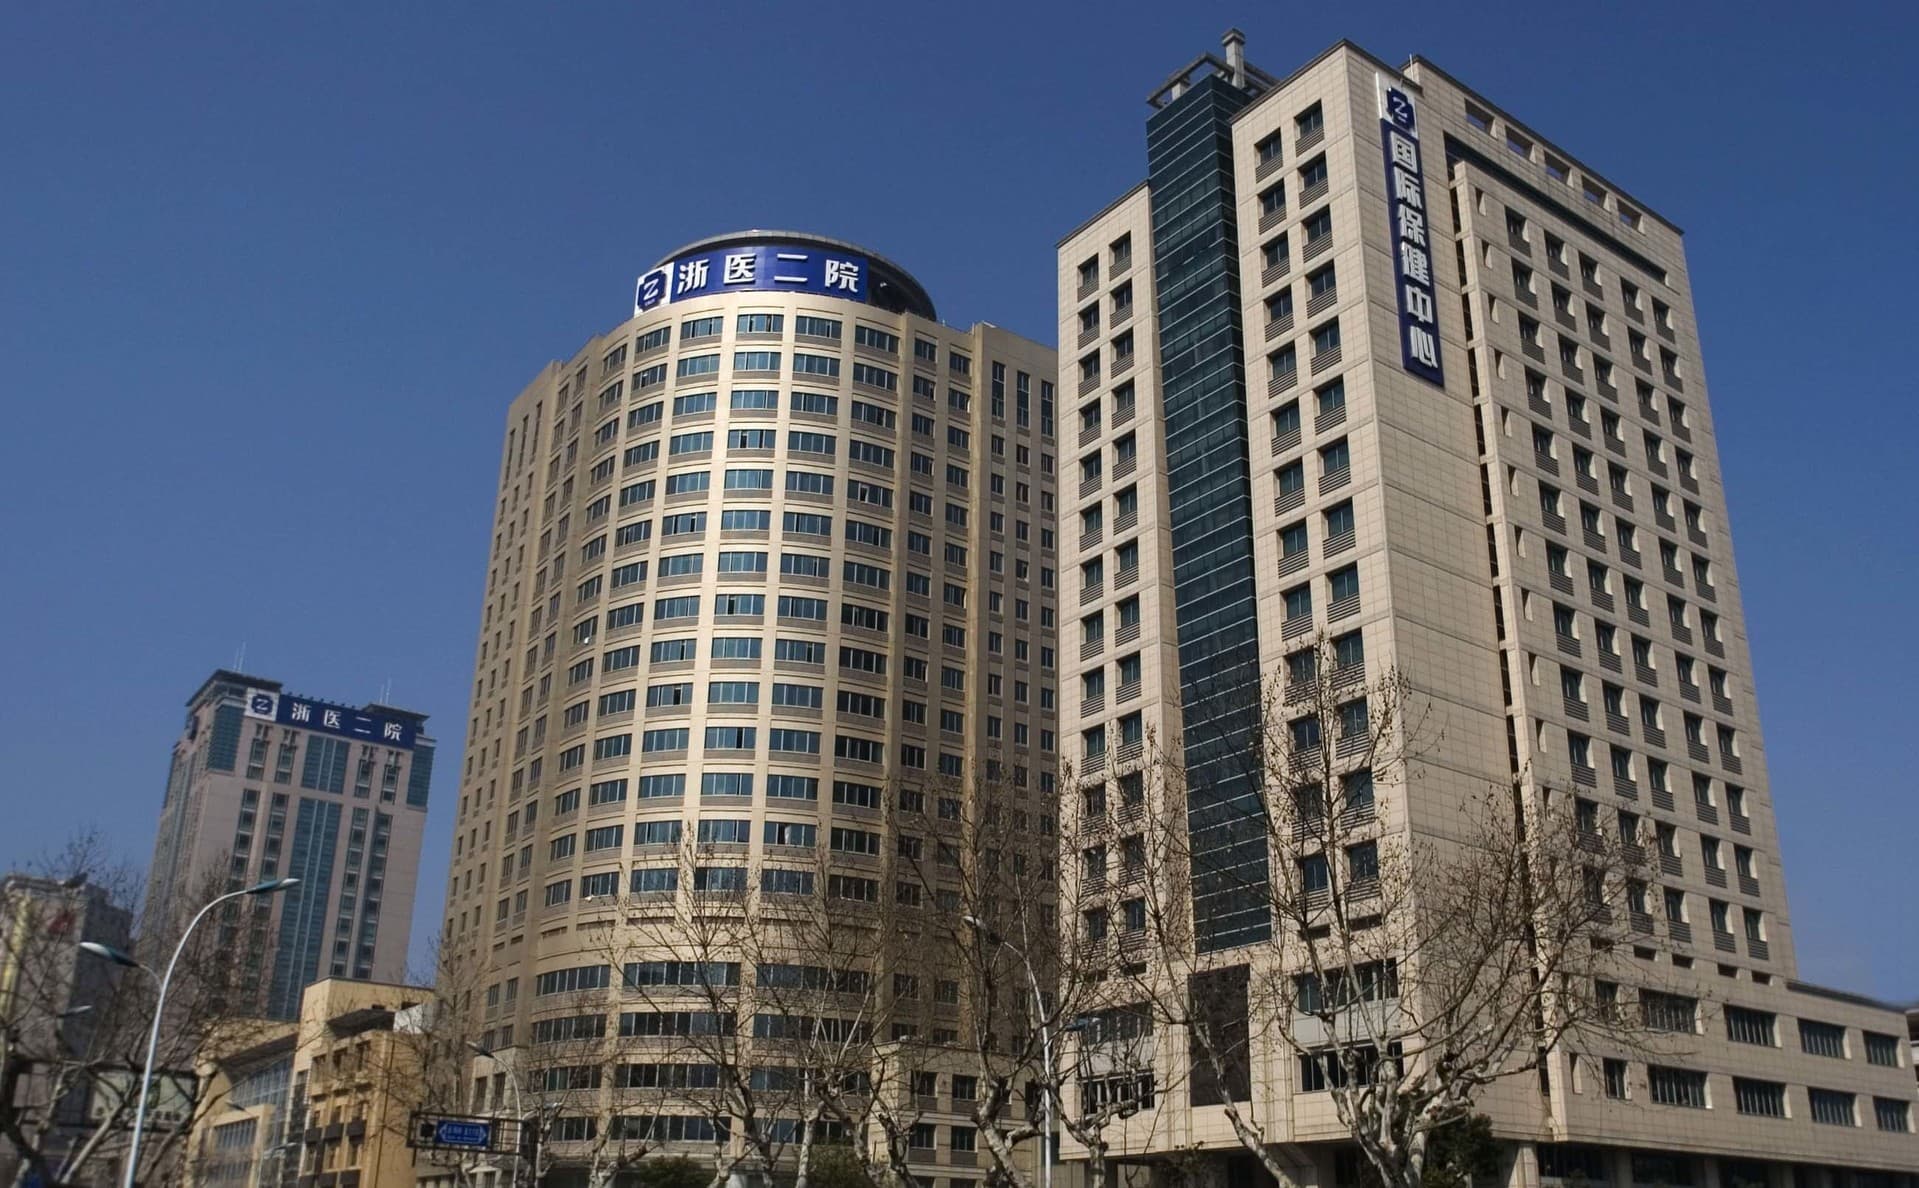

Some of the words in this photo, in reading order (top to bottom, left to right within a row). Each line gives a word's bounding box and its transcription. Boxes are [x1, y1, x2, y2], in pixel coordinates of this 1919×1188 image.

[1390, 130, 1438, 369] 国际保健中心
[676, 252, 859, 294] 浙医二院
[291, 702, 403, 742] 浙医二院
